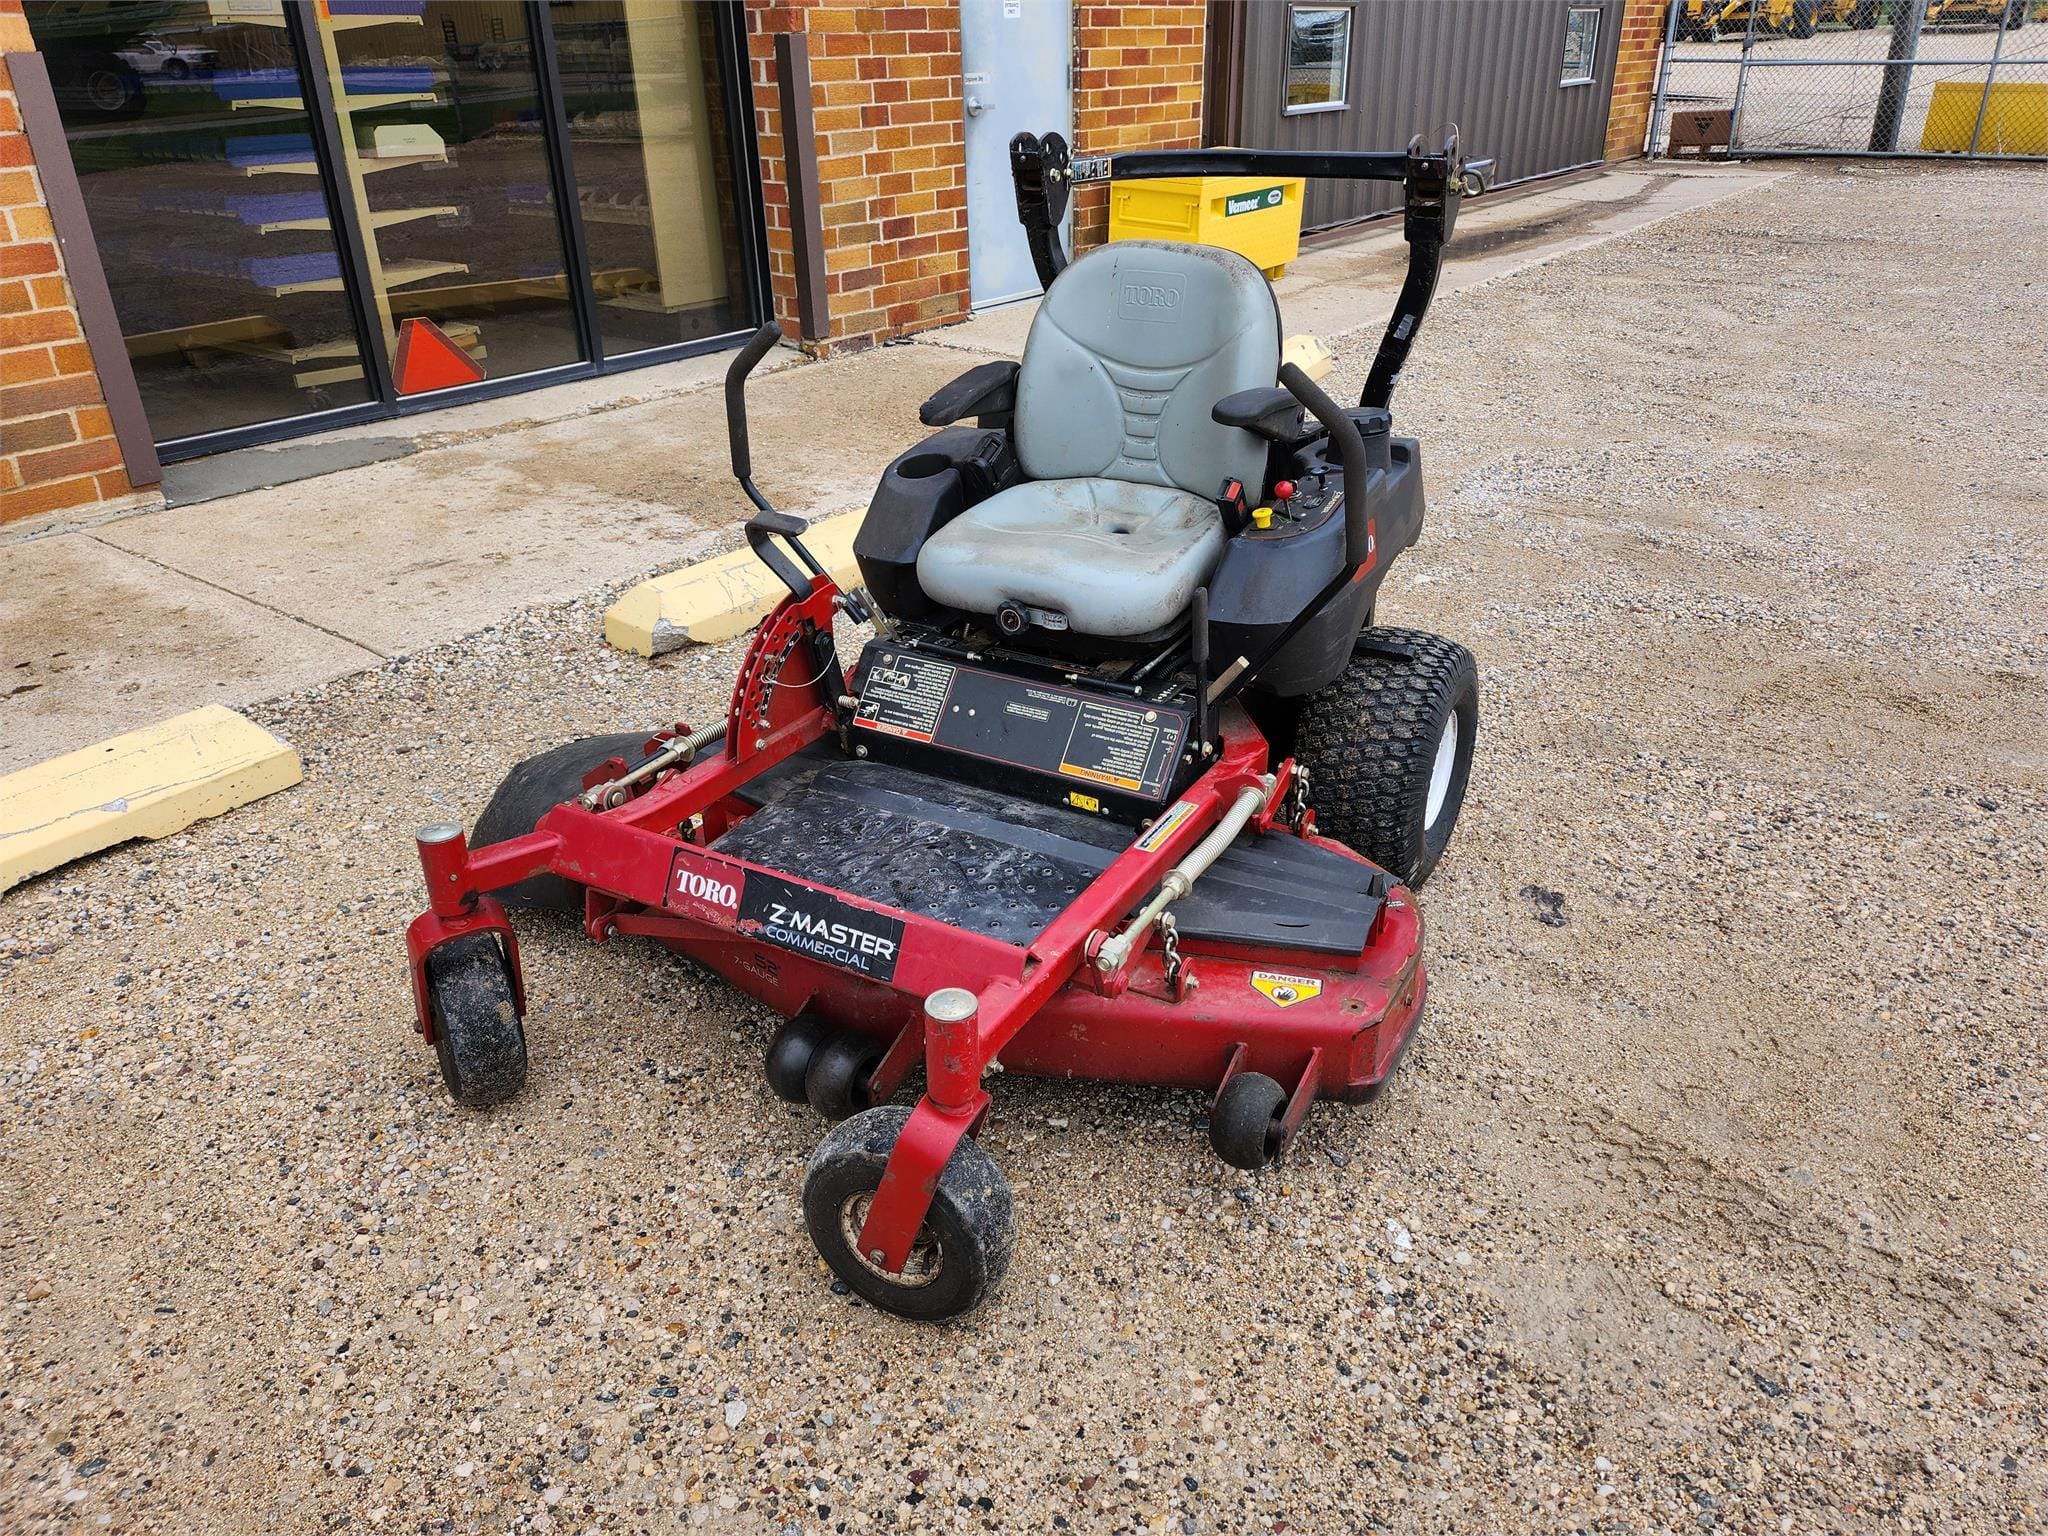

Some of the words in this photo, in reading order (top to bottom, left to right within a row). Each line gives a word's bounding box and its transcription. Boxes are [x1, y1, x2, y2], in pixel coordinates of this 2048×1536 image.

[1228, 197, 1260, 215] Vermeer
[1125, 285, 1180, 308] TORO
[1080, 769, 1111, 784] WARNING
[676, 869, 737, 908] TORO
[769, 903, 786, 924] Z
[789, 914, 895, 960] MASTER
[766, 926, 869, 971] COMMERCIAL
[1258, 973, 1316, 986] DANGER
